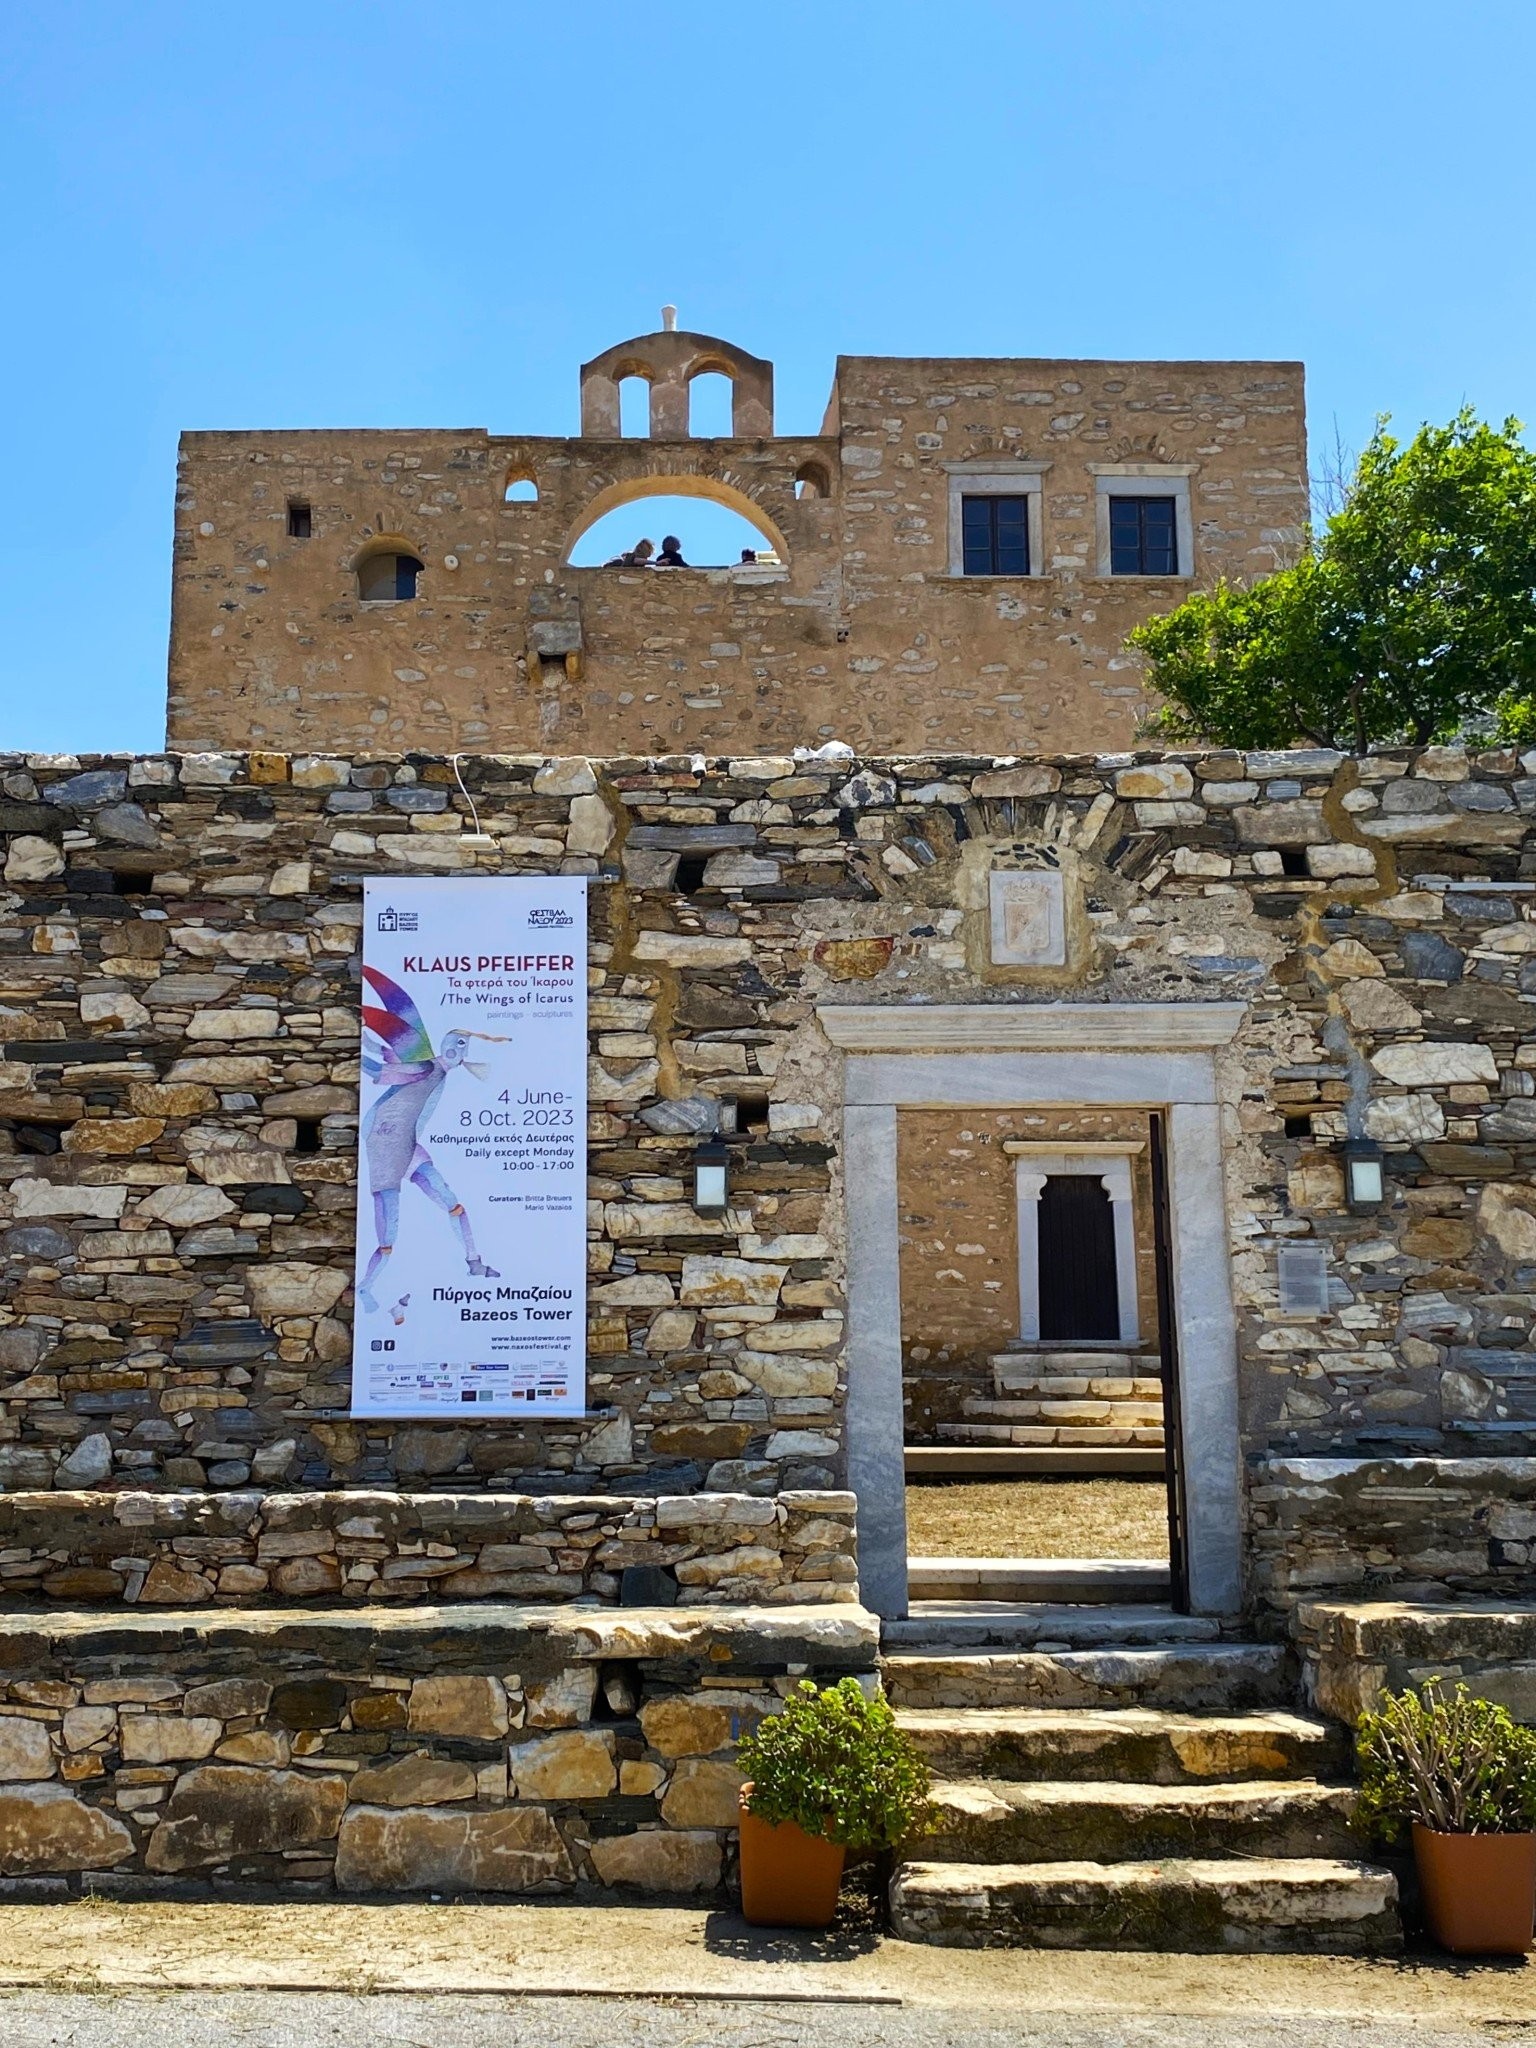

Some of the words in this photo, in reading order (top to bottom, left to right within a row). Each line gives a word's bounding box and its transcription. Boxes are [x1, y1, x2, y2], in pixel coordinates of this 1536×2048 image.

[555, 917, 574, 925] 2023
[404, 956, 471, 972] KLAUS
[478, 955, 573, 972] PFEIFFER
[447, 977, 461, 987] Τα
[465, 977, 503, 990] φτερά
[507, 979, 528, 988] του
[530, 976, 573, 989] Ίκαρου
[440, 993, 471, 1005] /The
[476, 994, 514, 1006] Wings
[519, 992, 531, 1003] of
[536, 993, 573, 1003] Icarus
[487, 1011, 524, 1020] paintings
[533, 1010, 573, 1018] sculptures
[498, 1089, 510, 1104] 4
[517, 1089, 572, 1104] June-
[460, 1110, 472, 1127] 8
[479, 1110, 515, 1126] Oct.
[523, 1110, 573, 1125] 2023
[430, 1134, 490, 1145] Καθημερινά
[494, 1134, 522, 1144] εκτός
[526, 1133, 574, 1144] Δευτέρας
[466, 1148, 491, 1159] Daily
[495, 1149, 529, 1158] except
[534, 1147, 574, 1158] Monday
[433, 1287, 491, 1304] Πύργος
[496, 1285, 573, 1302] Μπαζαίου
[461, 1309, 518, 1321] Bazeos
[523, 1308, 572, 1320] Tower
[491, 1343, 571, 1351] www.naxosfestival.gr
